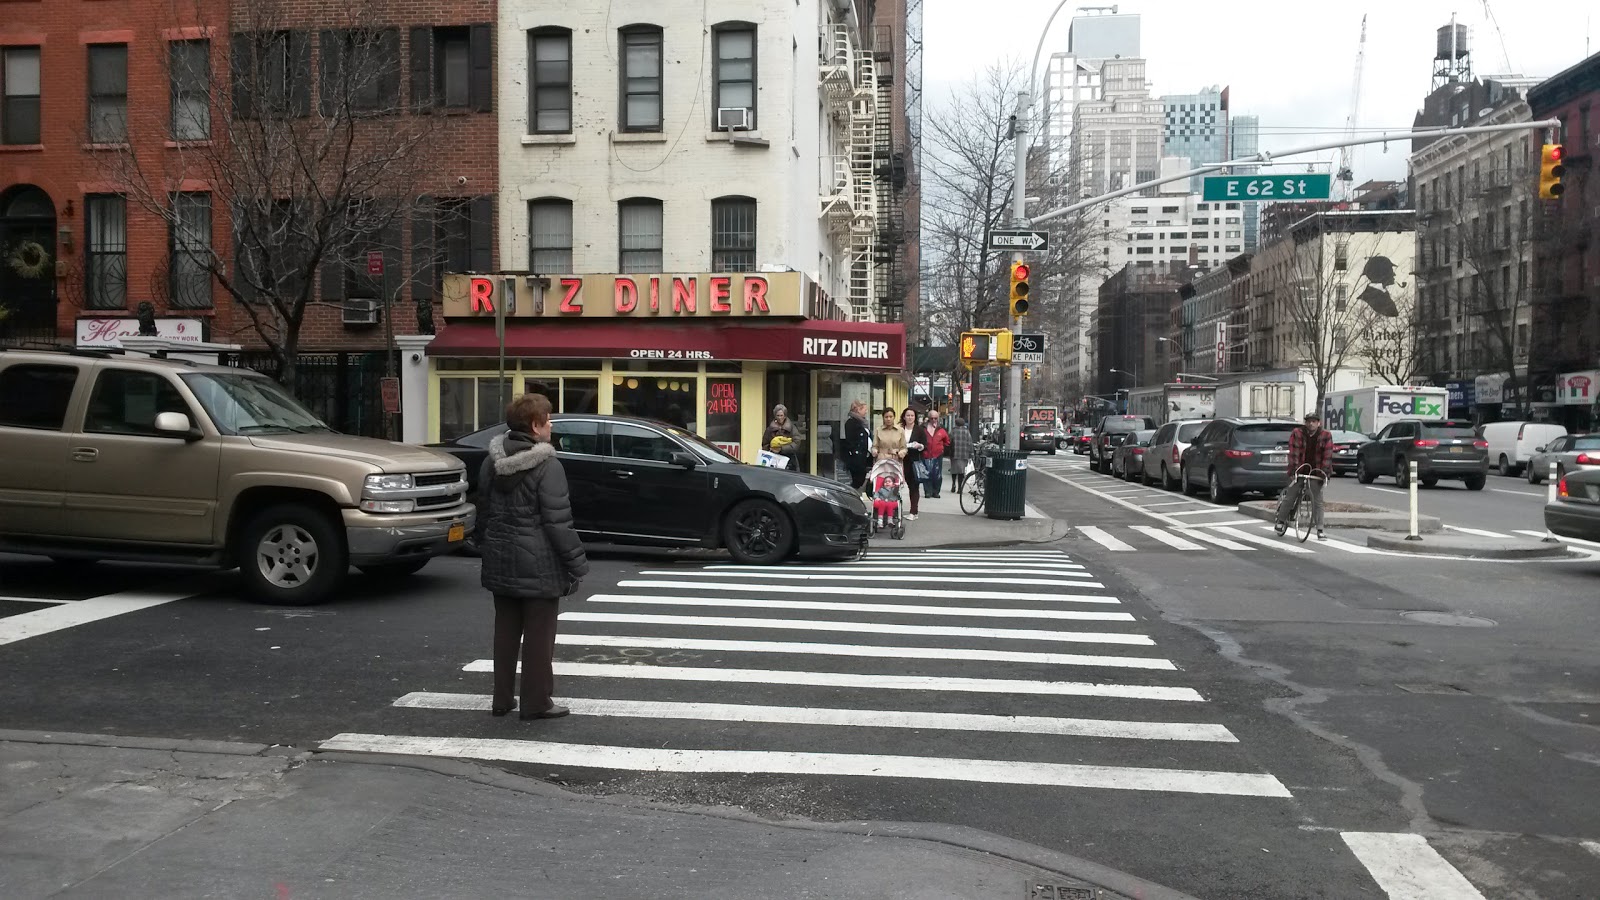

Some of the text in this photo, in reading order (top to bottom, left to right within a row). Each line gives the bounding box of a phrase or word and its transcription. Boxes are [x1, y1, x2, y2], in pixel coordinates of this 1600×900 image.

[1227, 180, 1307, 196] E 62 St
[997, 237, 1039, 245] ONE WAY
[470, 277, 583, 314] RITZ
[614, 276, 770, 314] DINER
[630, 349, 714, 359] OPEN 24 HRS.
[803, 337, 889, 359] RITZ DINER
[711, 383, 735, 398] OPEN
[706, 398, 738, 415] 24 HRS
[1324, 395, 1363, 431] FedEx
[1378, 396, 1441, 415] FedEx
[1031, 409, 1055, 421] ACE
